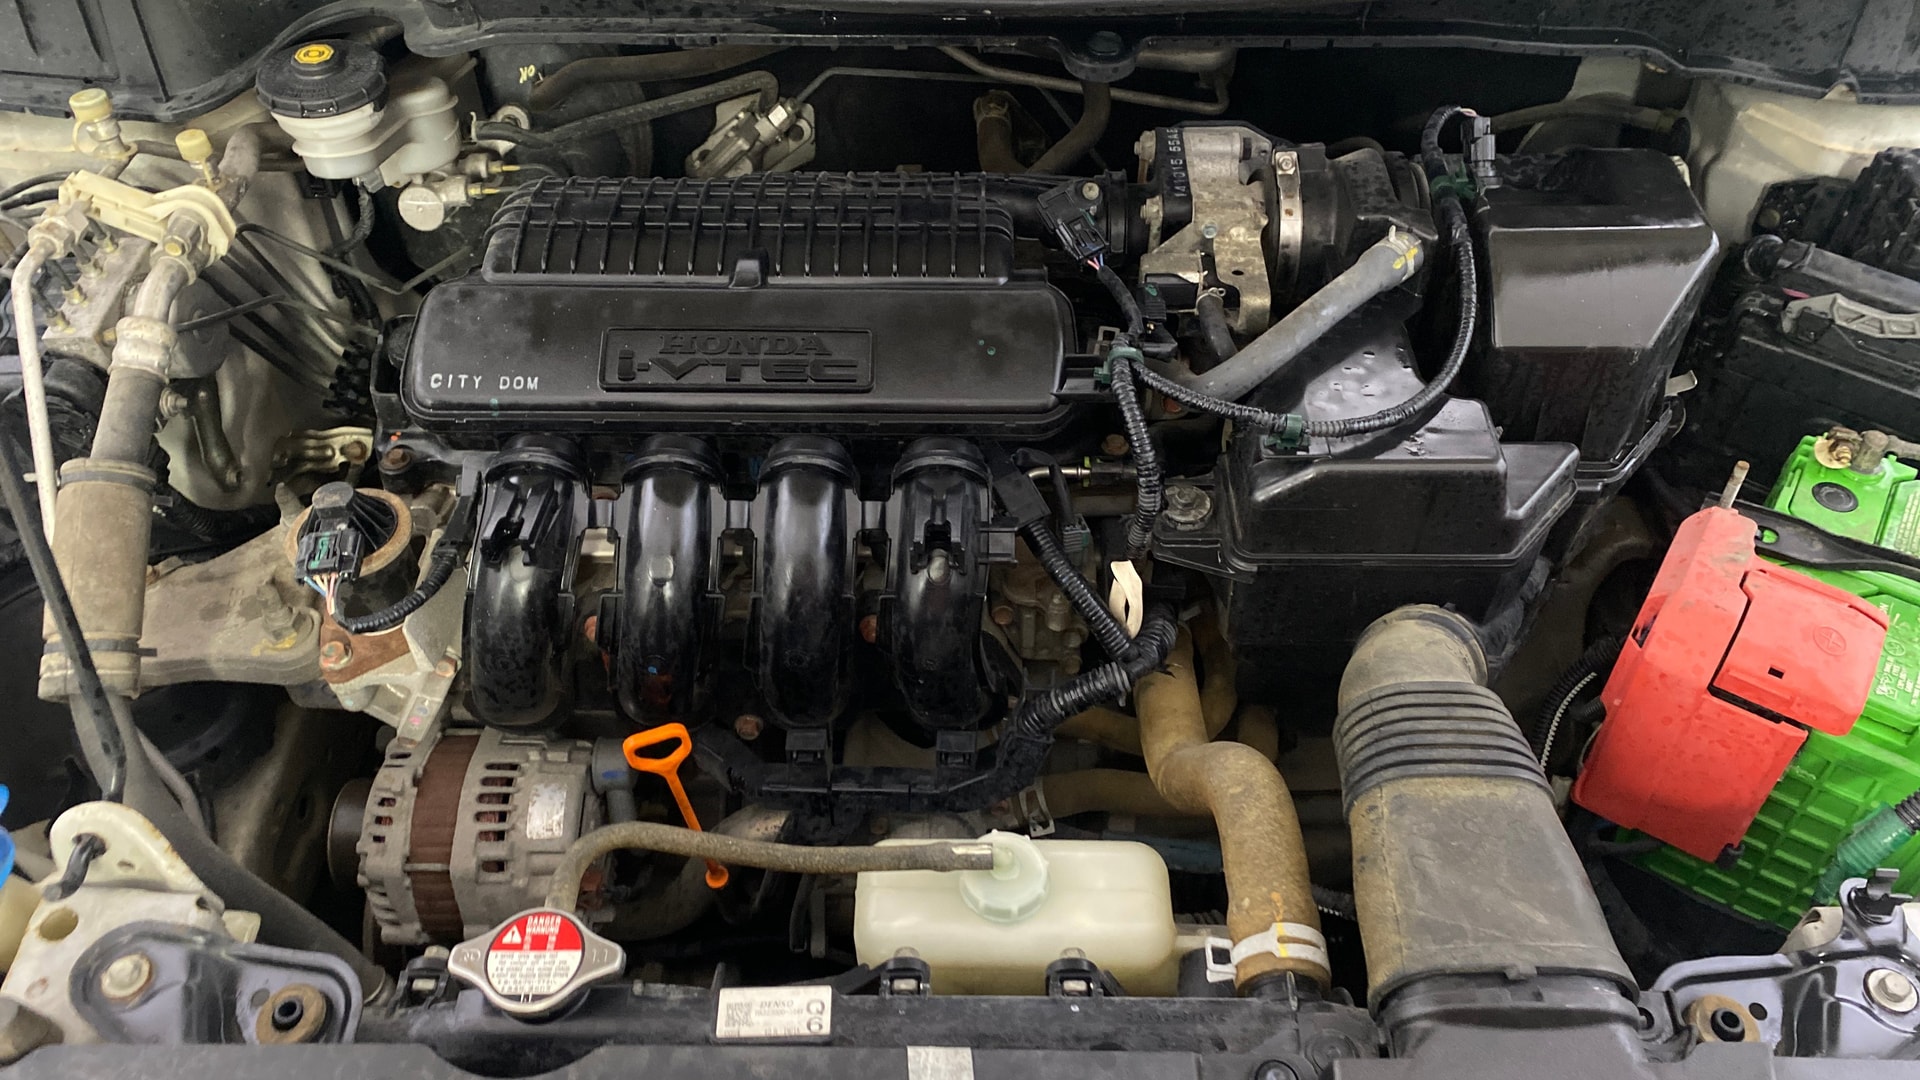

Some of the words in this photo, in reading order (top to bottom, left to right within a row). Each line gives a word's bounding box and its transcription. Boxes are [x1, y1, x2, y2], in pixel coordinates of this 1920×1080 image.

[659, 334, 833, 356] HONDA
[430, 373, 482, 389] CITY
[499, 376, 539, 390] DOM
[527, 915, 562, 926] DANGER
[760, 999, 794, 1009] DENSO
[806, 1016, 824, 1034] 6
